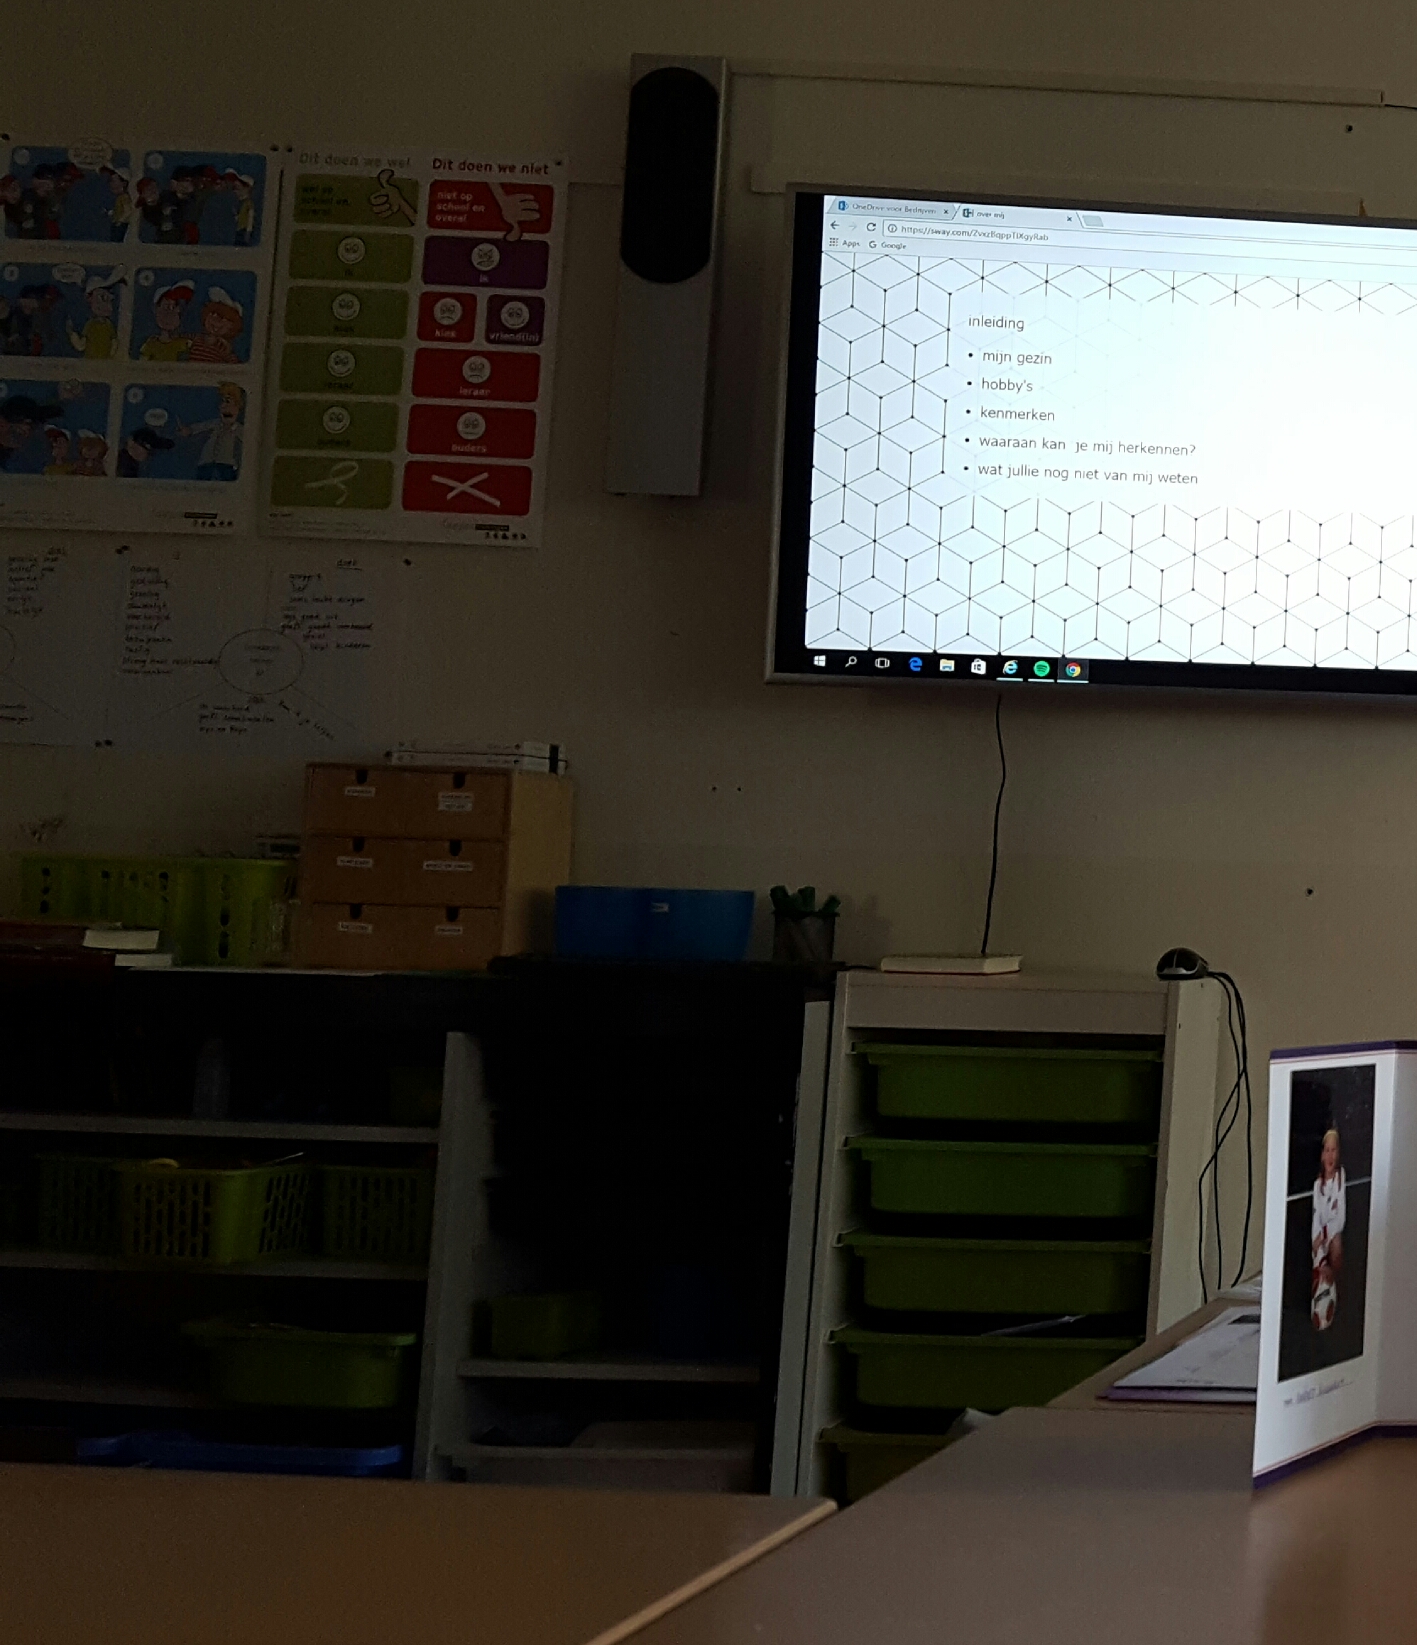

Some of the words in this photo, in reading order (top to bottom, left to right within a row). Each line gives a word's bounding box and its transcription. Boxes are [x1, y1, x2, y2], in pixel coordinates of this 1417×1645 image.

[432, 157, 454, 170] Dit
[459, 160, 493, 173] doen
[497, 163, 517, 174] we
[520, 160, 550, 175] niet
[881, 240, 907, 251] Google
[968, 314, 1025, 332] inleiding
[982, 350, 1012, 365] mijn
[1016, 353, 1052, 366] gezin
[981, 377, 1034, 394] hobby's
[980, 405, 1055, 422] kenmerken
[978, 436, 1037, 449] waaraan
[1042, 437, 1067, 450] kan
[1074, 440, 1089, 453] je
[1092, 440, 1114, 455] mij
[1118, 441, 1196, 457] herkennen?
[977, 464, 1003, 476] wat
[1006, 464, 1040, 479] jullie
[1044, 469, 1069, 482] nog
[1074, 469, 1100, 480] niet
[1103, 471, 1128, 482] van
[1132, 471, 1153, 486] mij
[1157, 473, 1199, 485] weten
